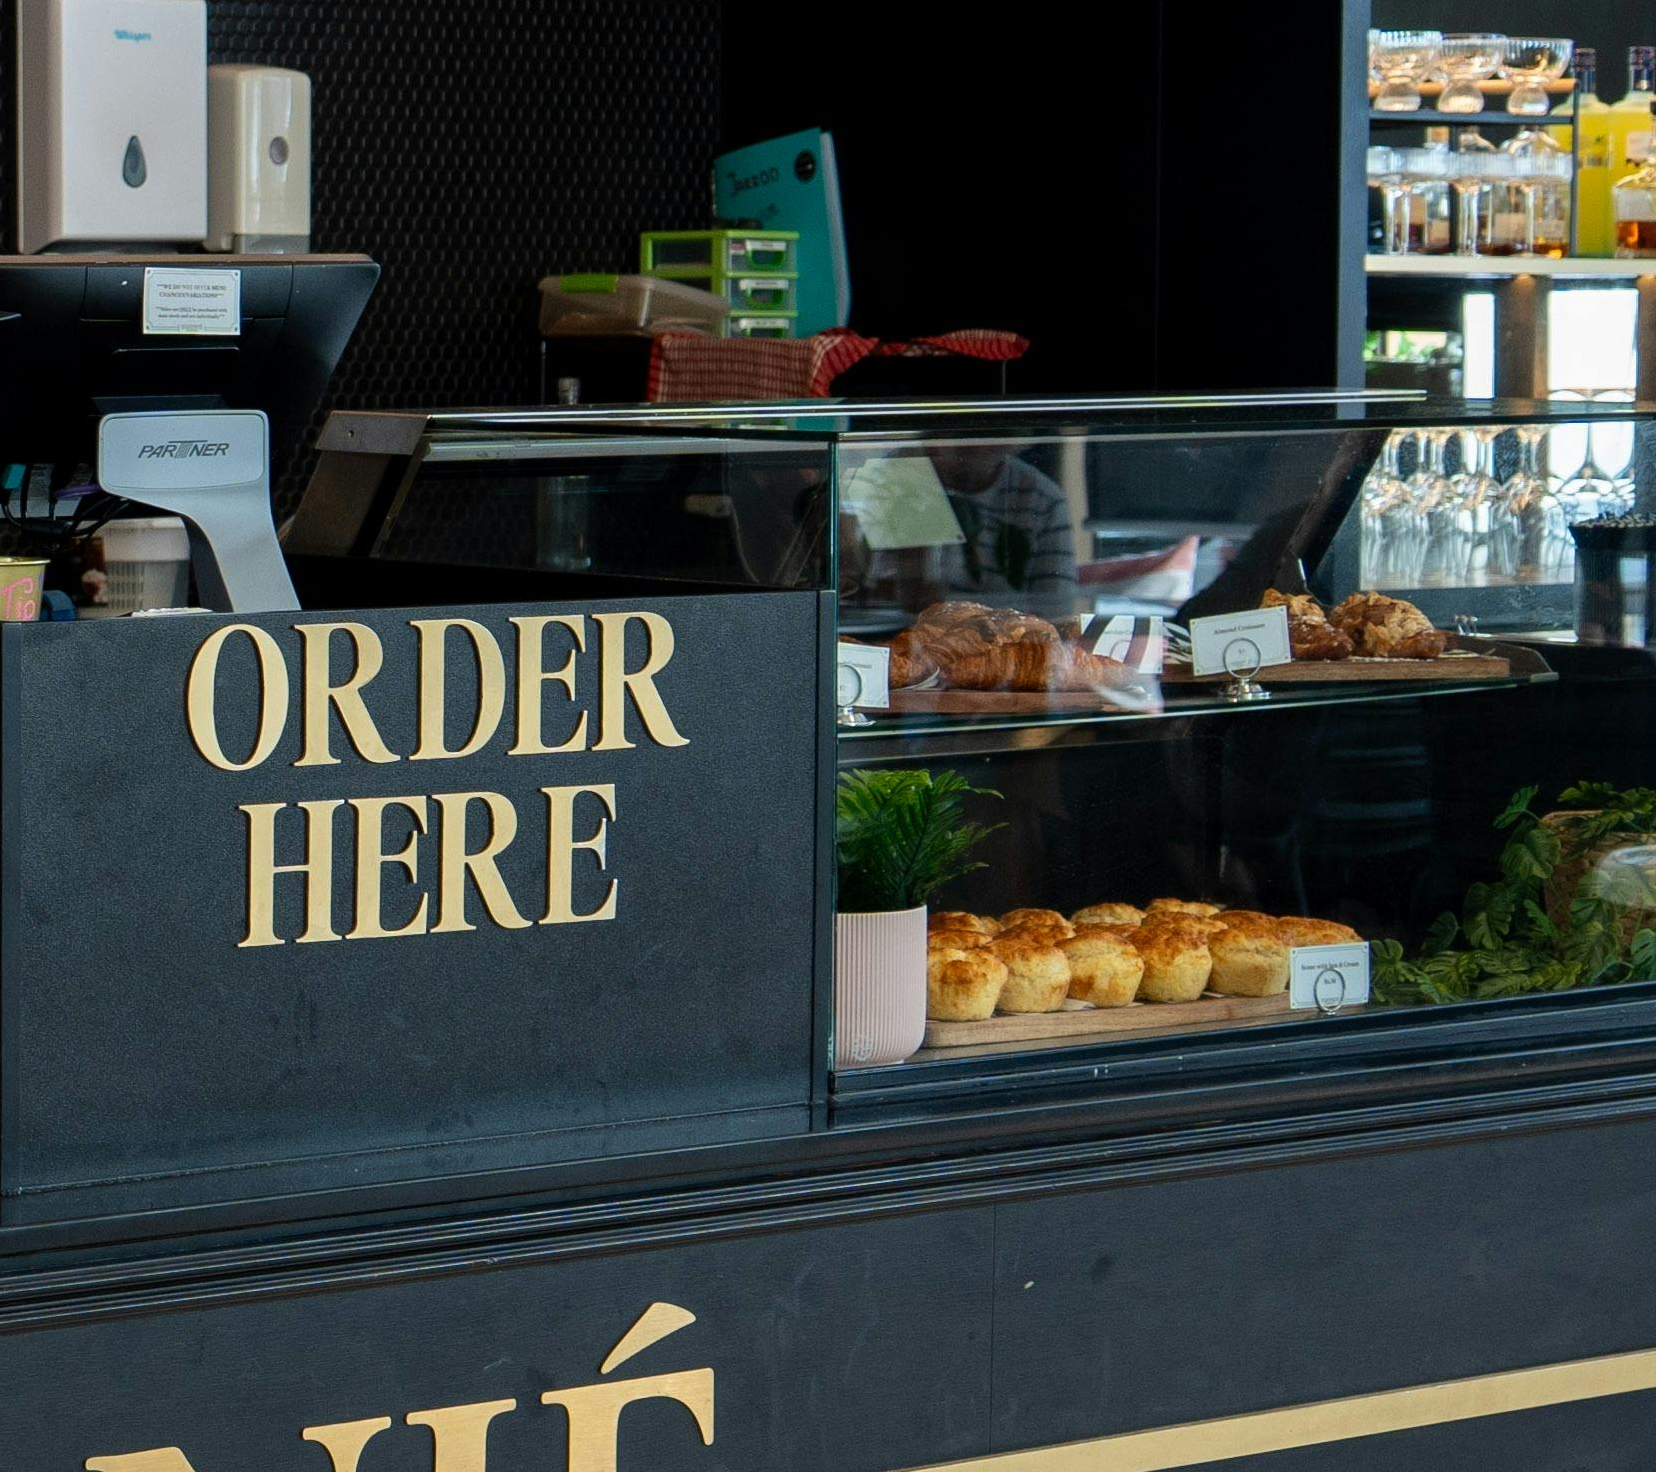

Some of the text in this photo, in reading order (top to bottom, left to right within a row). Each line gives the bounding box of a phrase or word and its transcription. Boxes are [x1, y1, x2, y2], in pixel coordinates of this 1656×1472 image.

[138, 440, 230, 459] PARTNER
[187, 611, 691, 772] ORDER
[237, 782, 619, 948] HERE
